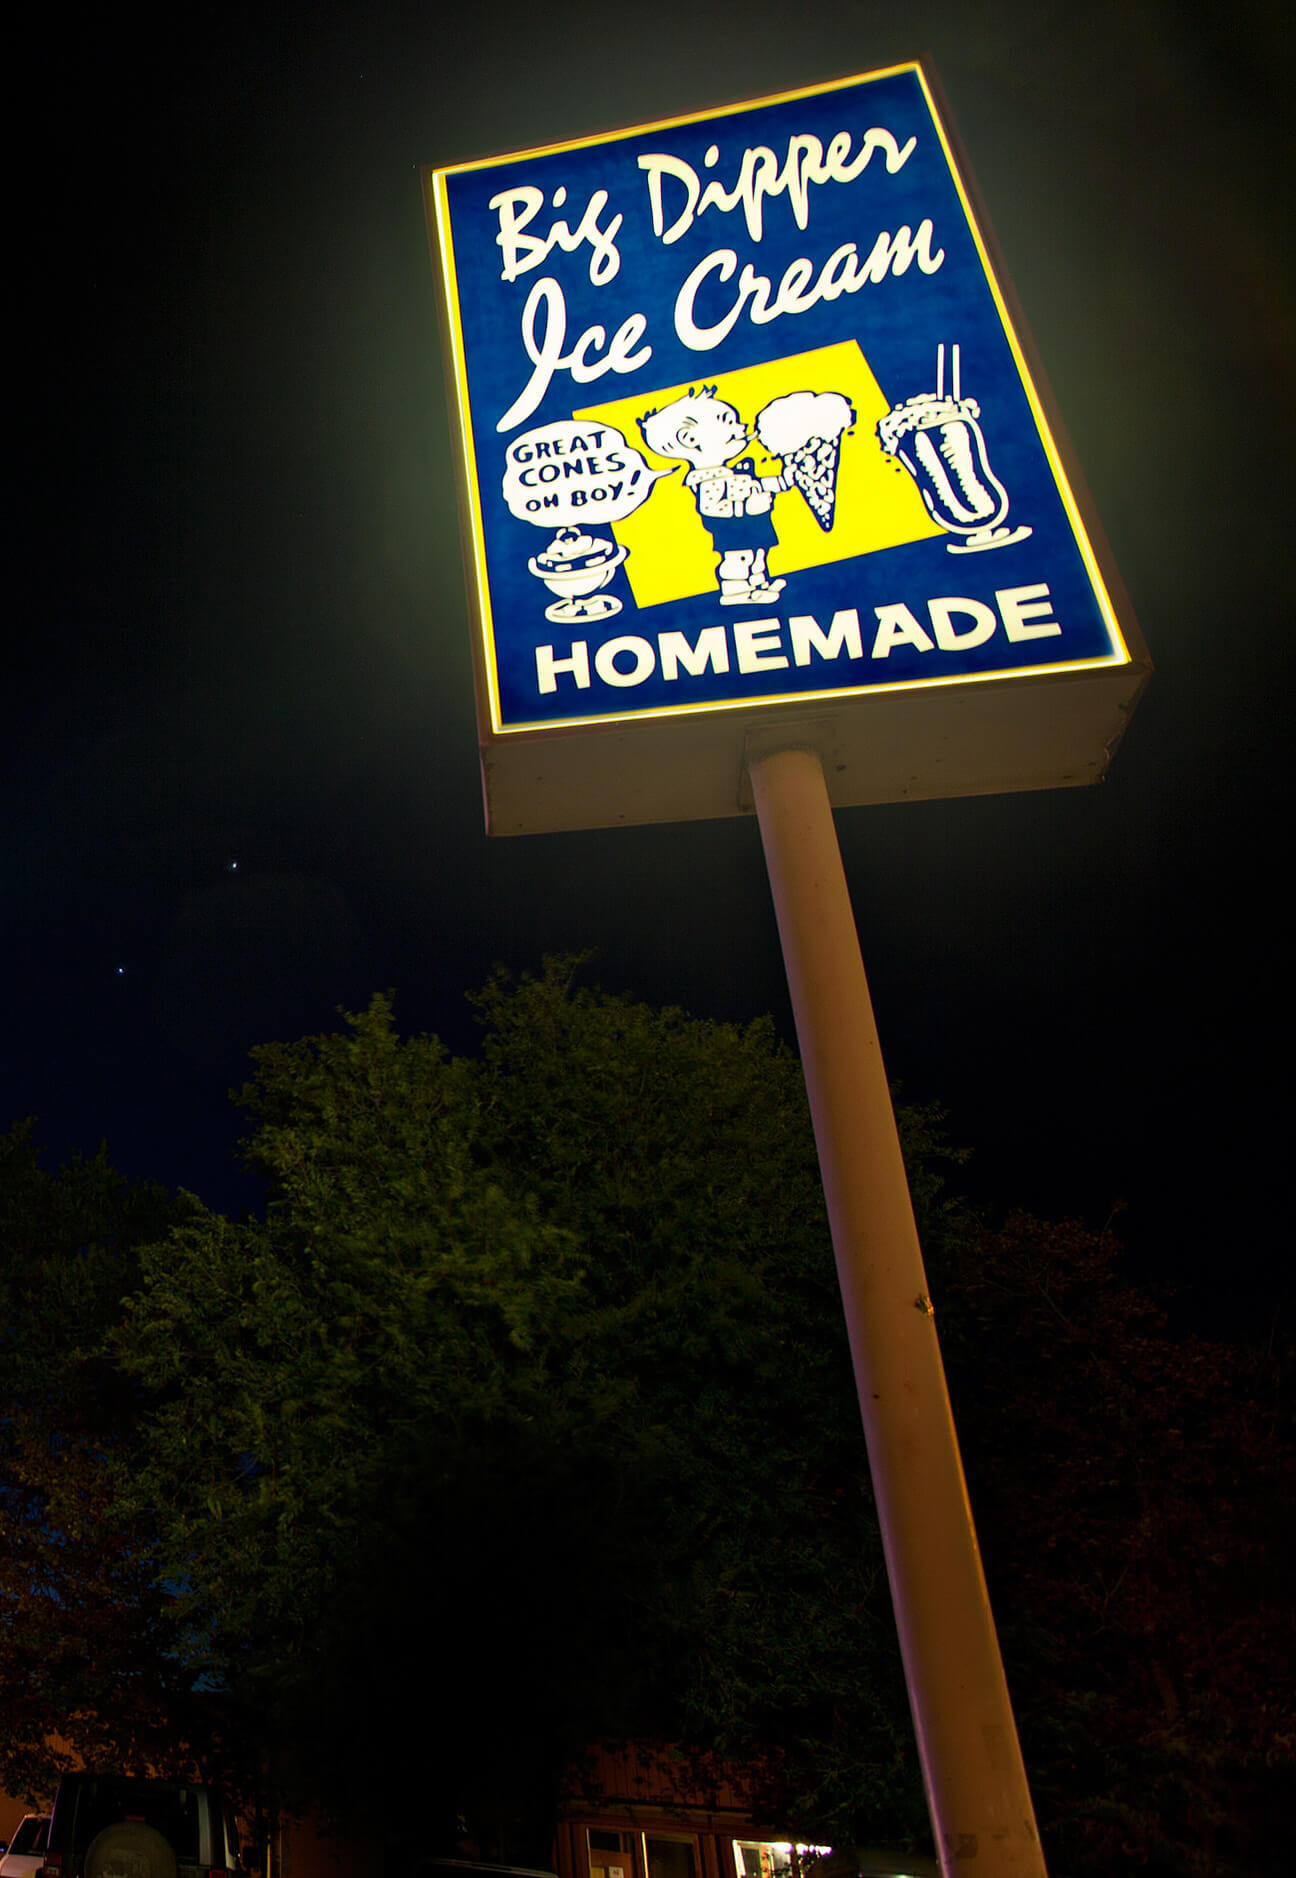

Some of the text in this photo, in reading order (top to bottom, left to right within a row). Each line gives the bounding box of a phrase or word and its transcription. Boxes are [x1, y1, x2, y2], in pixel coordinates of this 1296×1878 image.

[489, 127, 917, 286] Big Dipper
[497, 220, 945, 433] Ice Cream
[512, 430, 606, 463] GREAT
[518, 452, 626, 487] CONES
[525, 469, 641, 512] OH BOY!
[535, 583, 1062, 694] HOMEMADE
